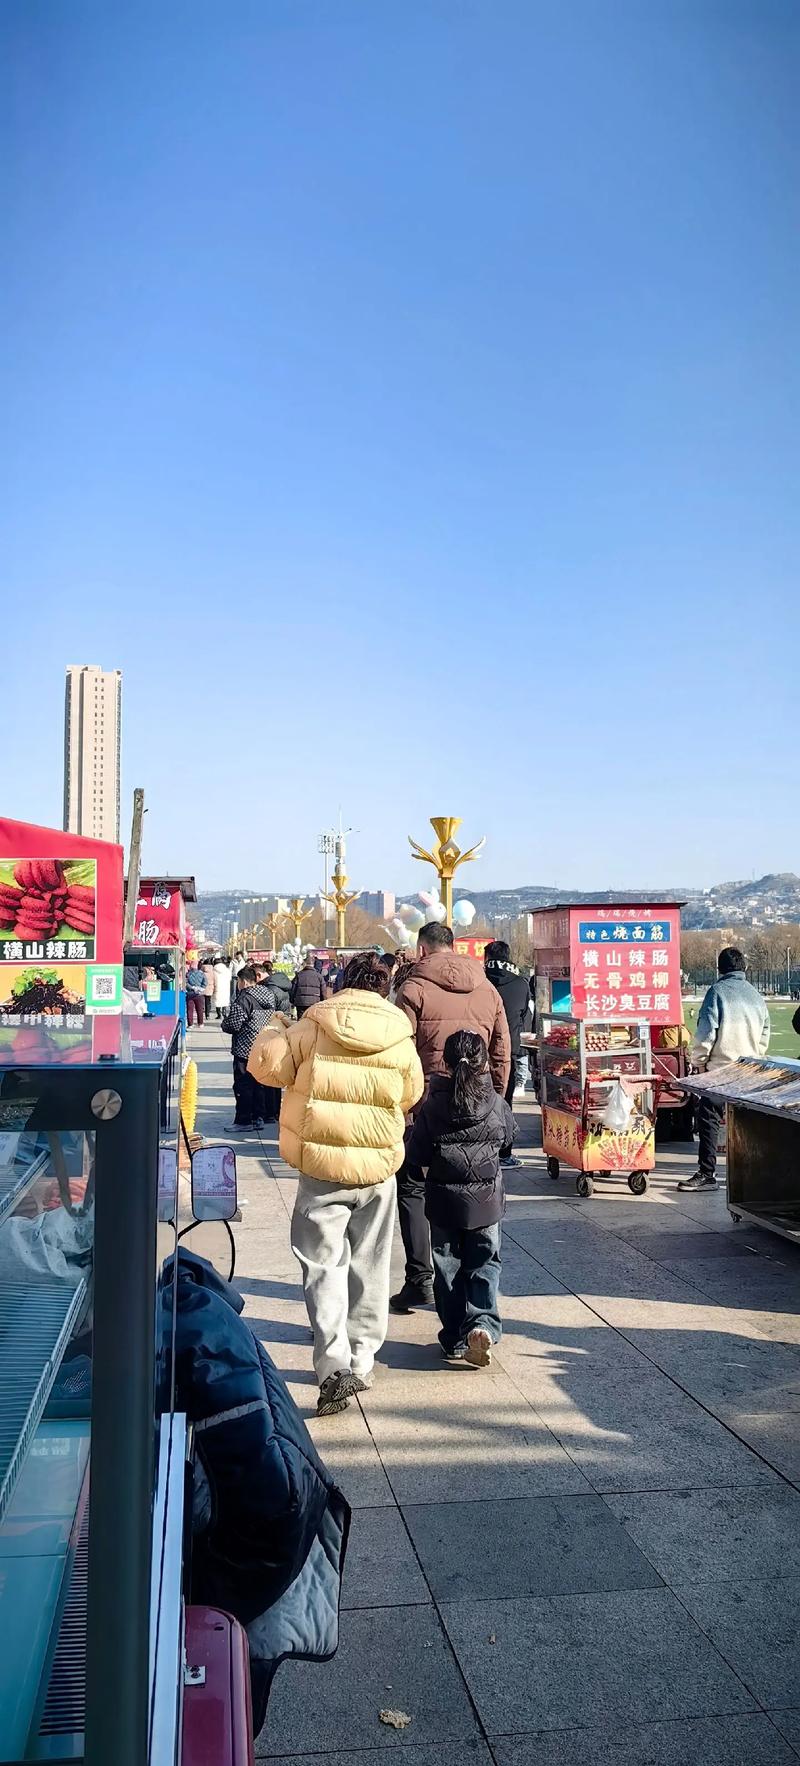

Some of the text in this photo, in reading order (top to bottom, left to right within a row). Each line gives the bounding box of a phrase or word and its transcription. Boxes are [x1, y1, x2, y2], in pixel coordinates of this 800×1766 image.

[585, 924, 664, 941] 特色烧面筋
[3, 941, 87, 959] 横山辣肠
[582, 949, 669, 967] 横山辣肠
[583, 971, 669, 989] 无骨鸡柳
[584, 993, 671, 1011] 长沙臭豆腐
